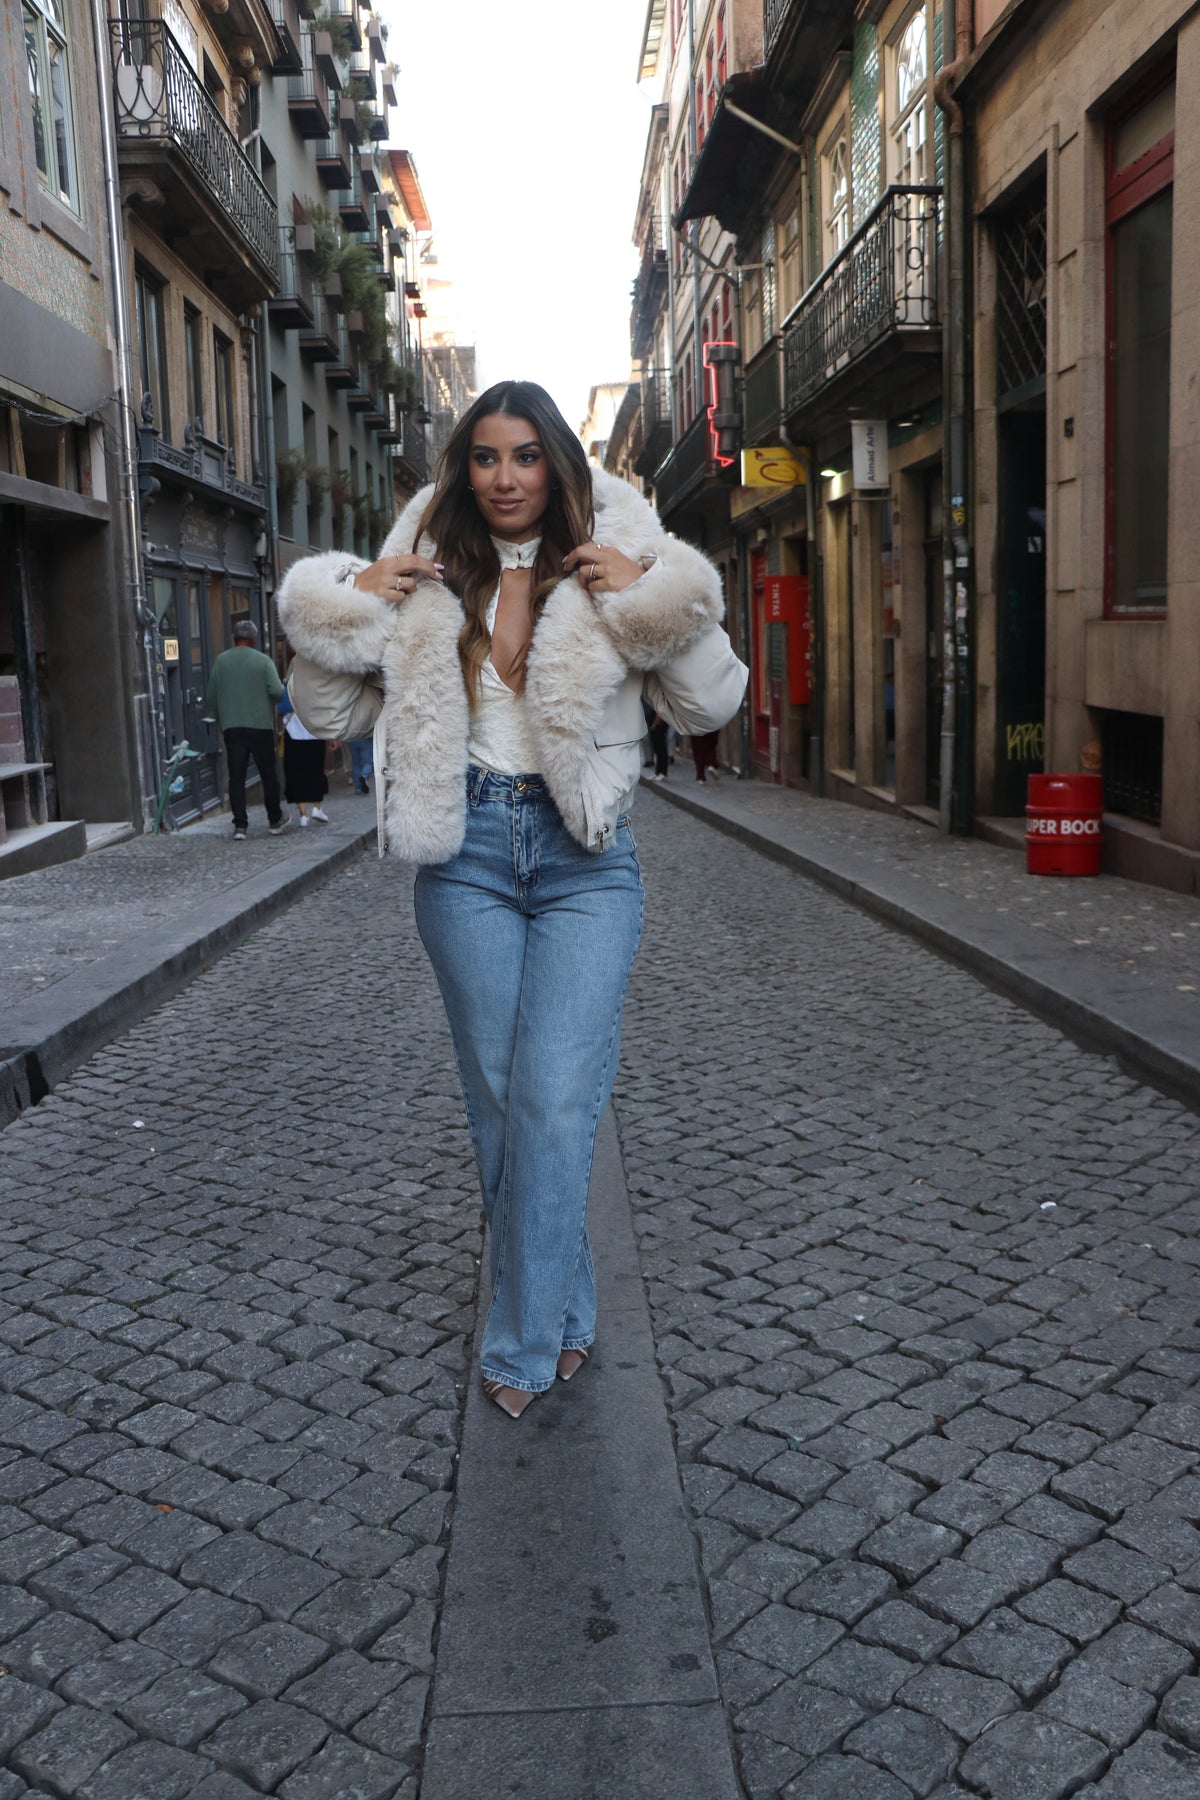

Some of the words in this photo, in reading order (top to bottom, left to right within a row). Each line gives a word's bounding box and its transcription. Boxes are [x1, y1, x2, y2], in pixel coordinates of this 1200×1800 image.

[772, 583, 780, 616] TINTAS
[166, 643, 177, 656] ATM
[1027, 819, 1057, 834] UPER
[1060, 819, 1099, 835] BOCK
